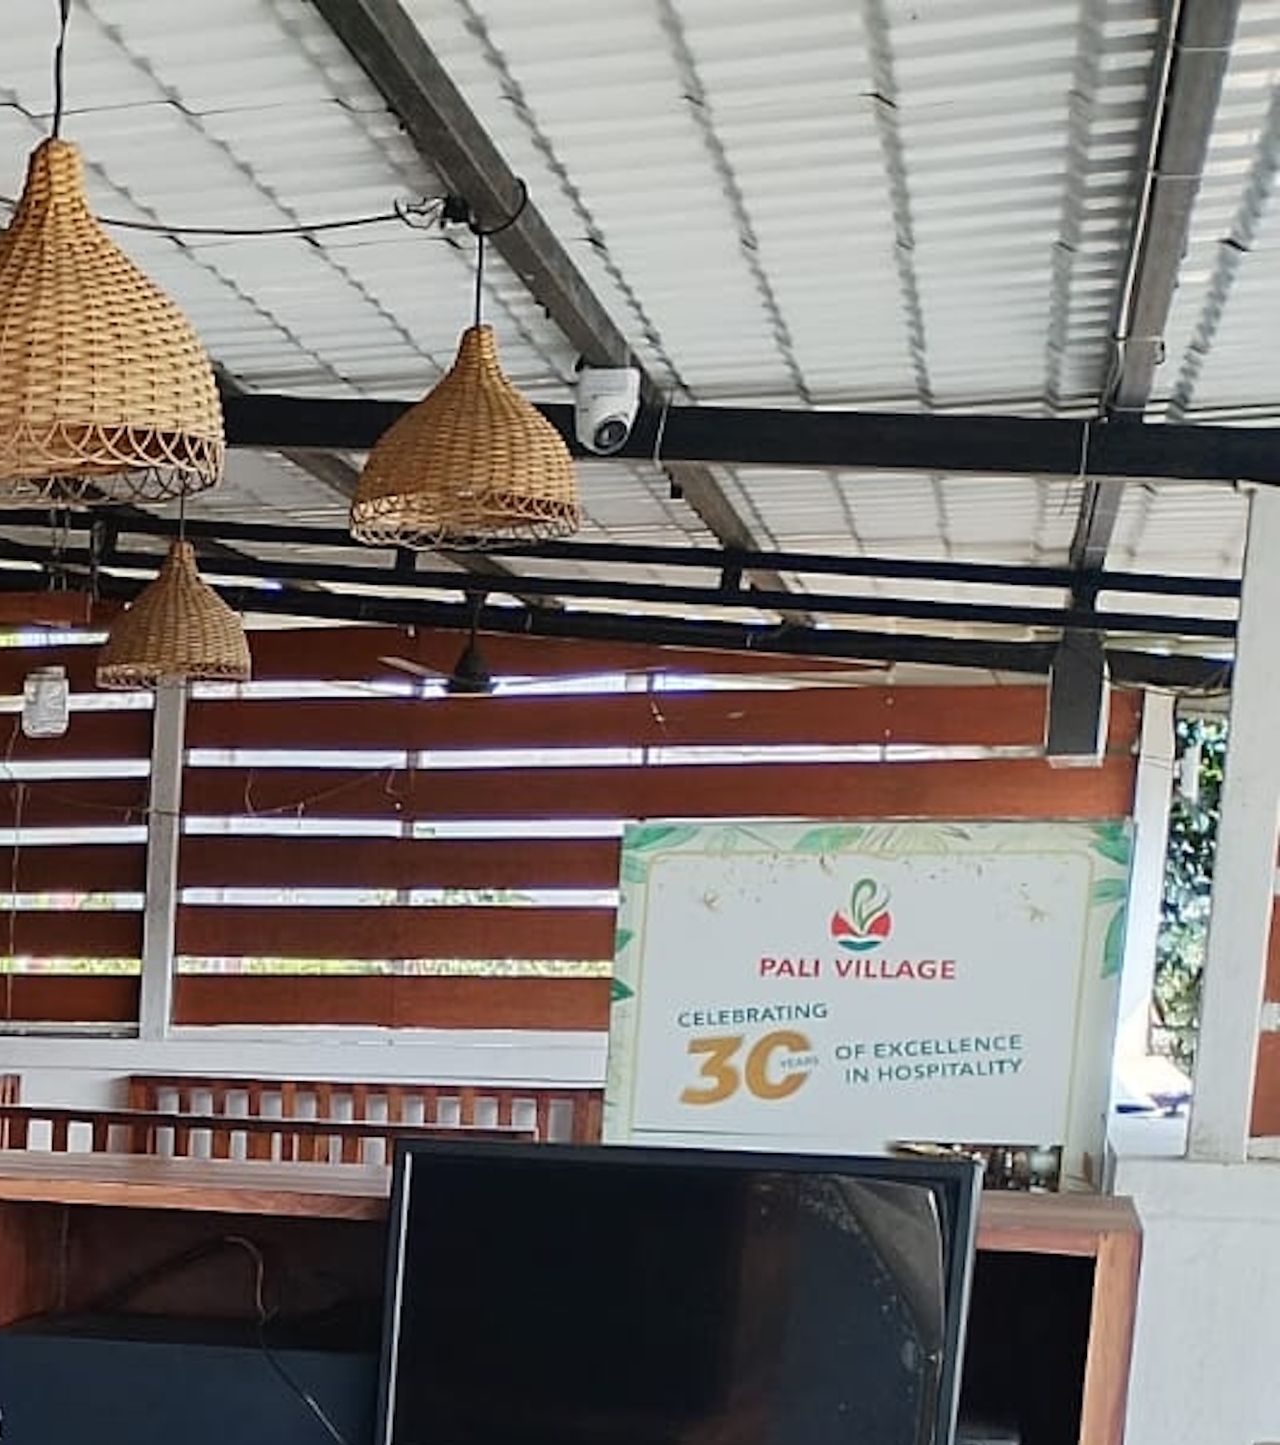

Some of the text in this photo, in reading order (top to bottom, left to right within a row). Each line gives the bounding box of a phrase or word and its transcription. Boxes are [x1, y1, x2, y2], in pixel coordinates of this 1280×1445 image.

[759, 957, 957, 981] PALI VILLAGE
[677, 1002, 828, 1028] CELEBRATING
[834, 1033, 1023, 1061] OF EXCELLENCE
[845, 1057, 1023, 1084] IN HOSPITALITY
